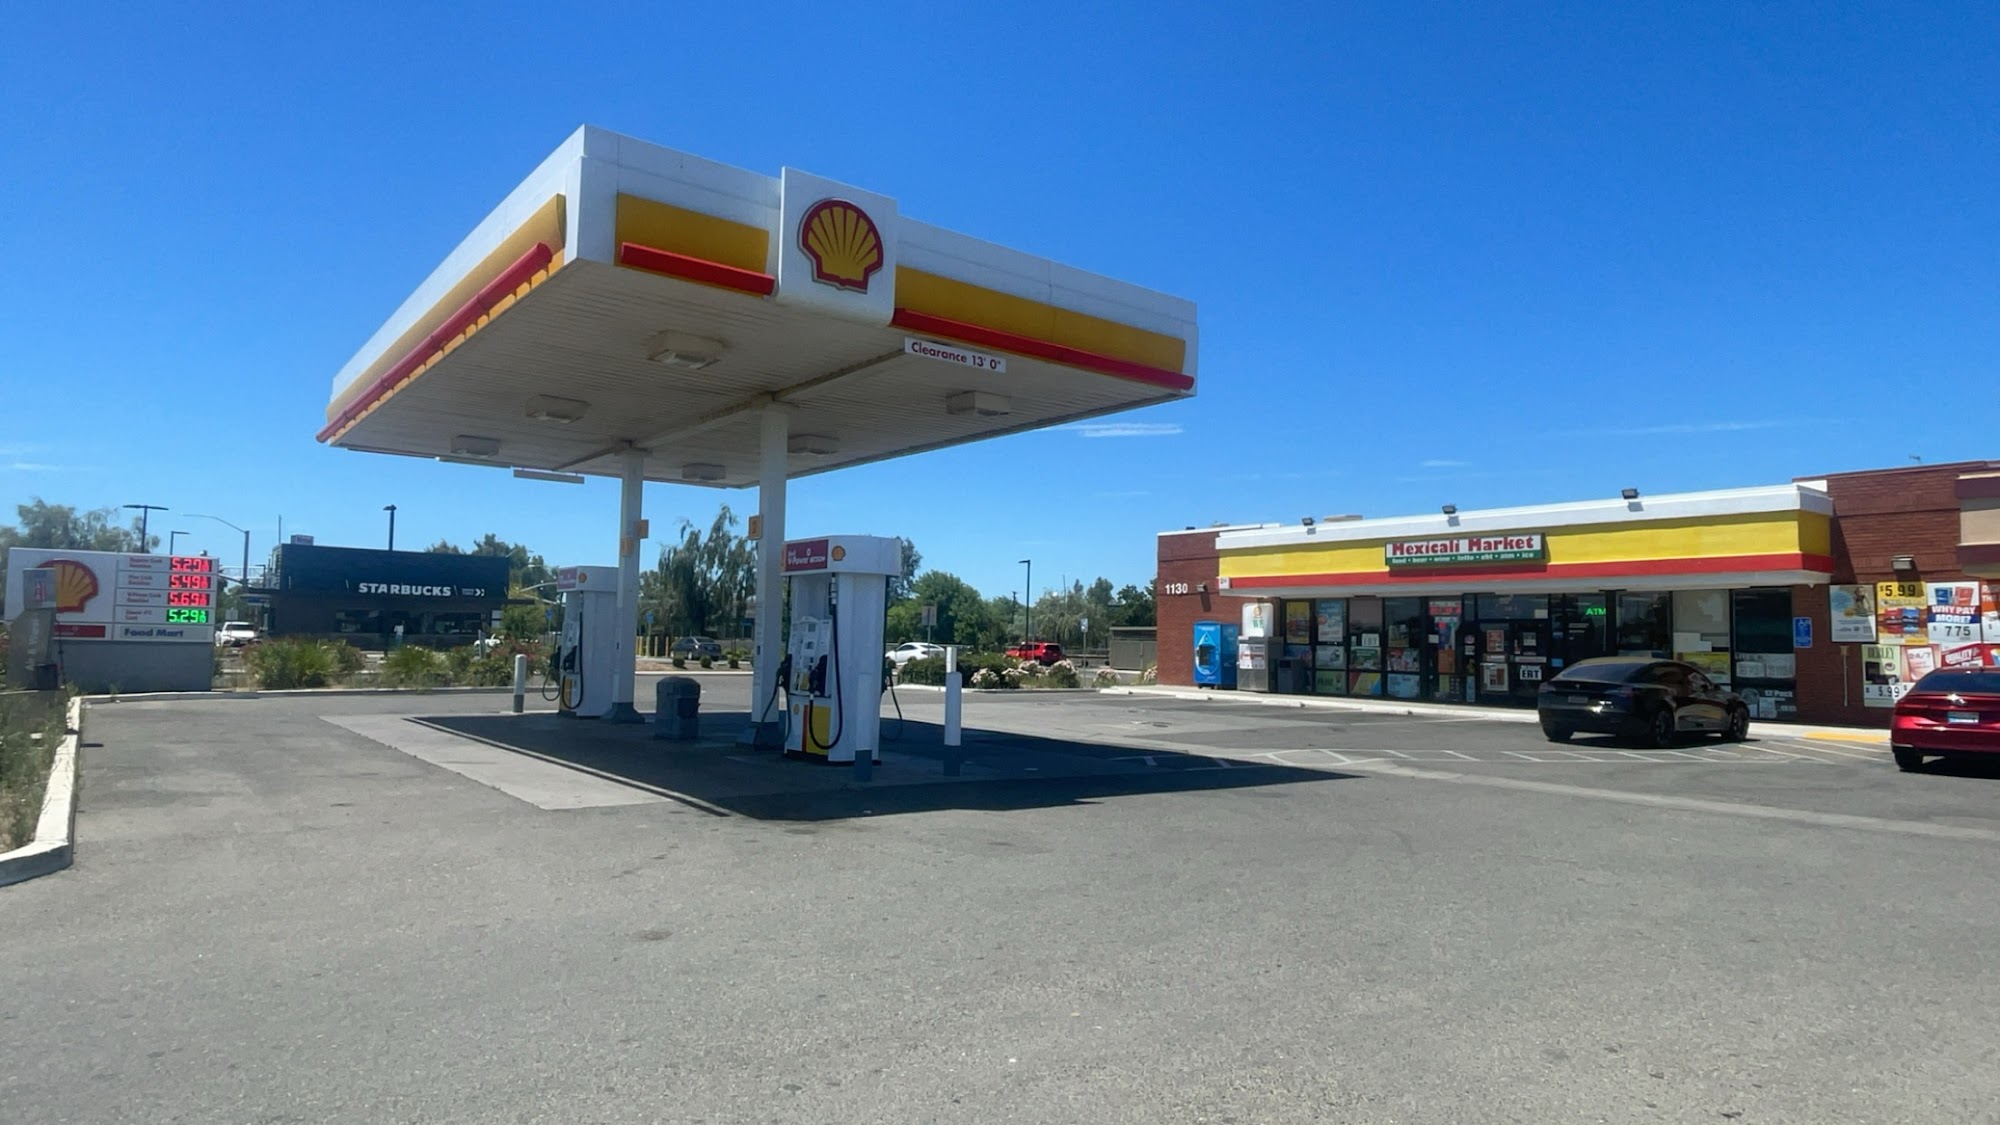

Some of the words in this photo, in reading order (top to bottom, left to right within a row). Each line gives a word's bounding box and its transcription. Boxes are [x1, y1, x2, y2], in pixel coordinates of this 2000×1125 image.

[911, 342, 967, 363] Clearance
[1392, 540, 1460, 555] Mexicali
[1468, 536, 1534, 551] Market
[358, 582, 451, 596] STARBUCKS
[1165, 583, 1188, 595] 1130
[1932, 605, 1954, 613] WHY
[1956, 606, 1976, 614] PAY
[1935, 614, 1972, 623] MORE?
[124, 628, 153, 637] Food
[156, 629, 184, 637] Mart
[1909, 652, 1931, 660] 24/7
